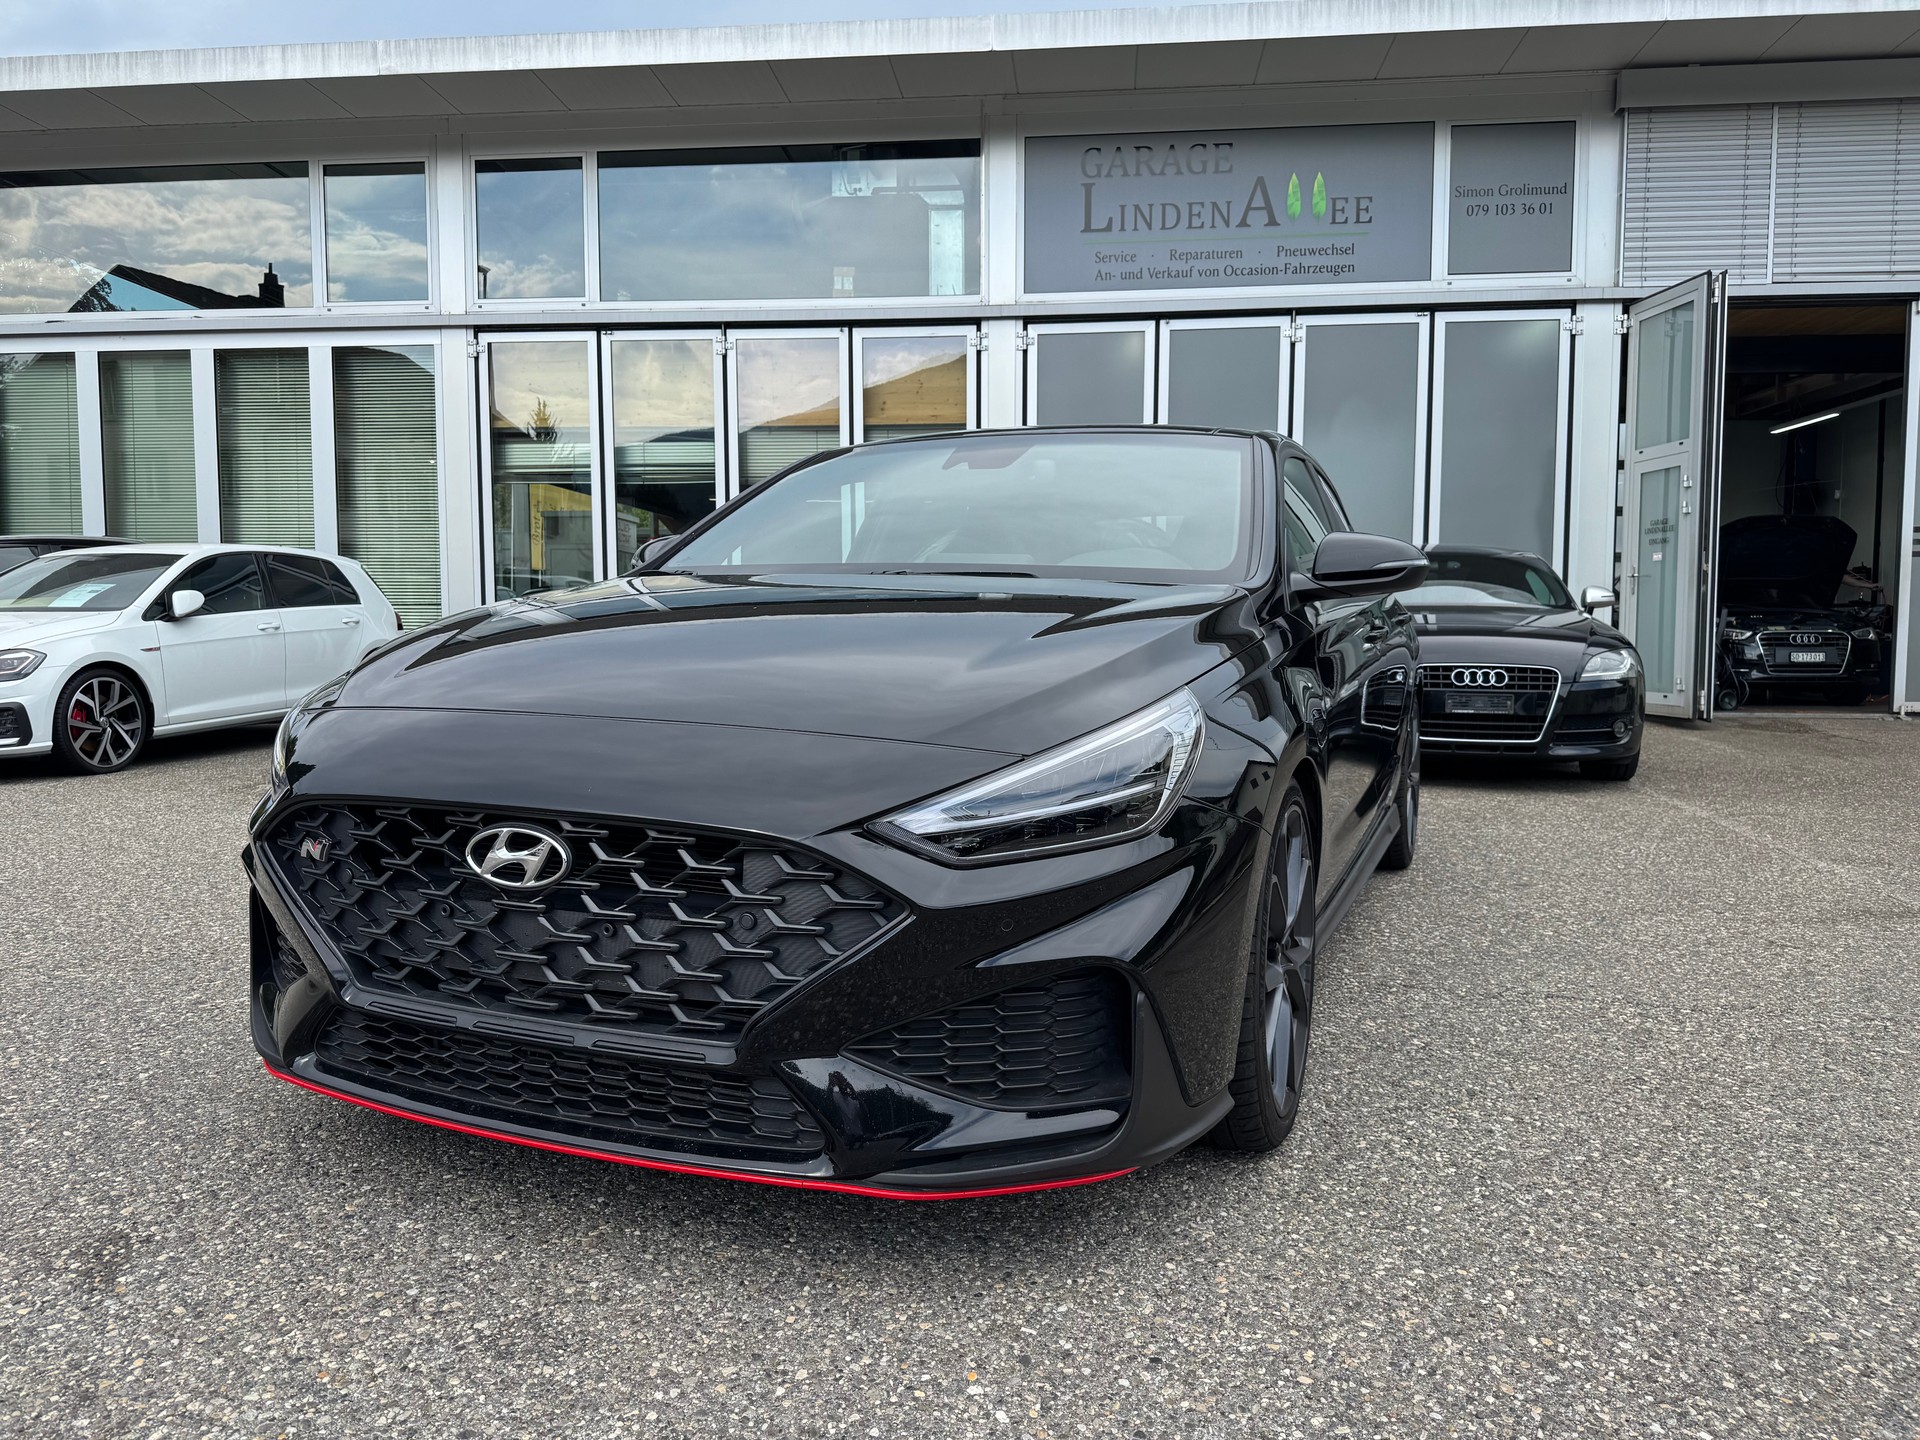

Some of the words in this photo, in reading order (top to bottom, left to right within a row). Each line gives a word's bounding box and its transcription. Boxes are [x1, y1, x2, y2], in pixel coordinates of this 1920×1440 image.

[1080, 142, 1234, 179] GARAGE
[1454, 185, 1494, 198] Simon
[1498, 182, 1568, 197] Grolimund
[1080, 174, 1374, 234] LINDENAEE
[1466, 203, 1489, 217] 079
[1495, 203, 1516, 216] 103
[1520, 202, 1535, 215] 36
[1539, 202, 1553, 215] 01
[1094, 250, 1137, 264] Service
[1169, 248, 1243, 263] Reparaturen
[1276, 243, 1355, 258] Pneuwechsel
[1094, 269, 1116, 281] An-
[1120, 267, 1143, 281] und
[1147, 265, 1193, 280] Verkauf
[1197, 267, 1220, 278] von
[1223, 262, 1355, 279] Occasion-Fahrzeugen
